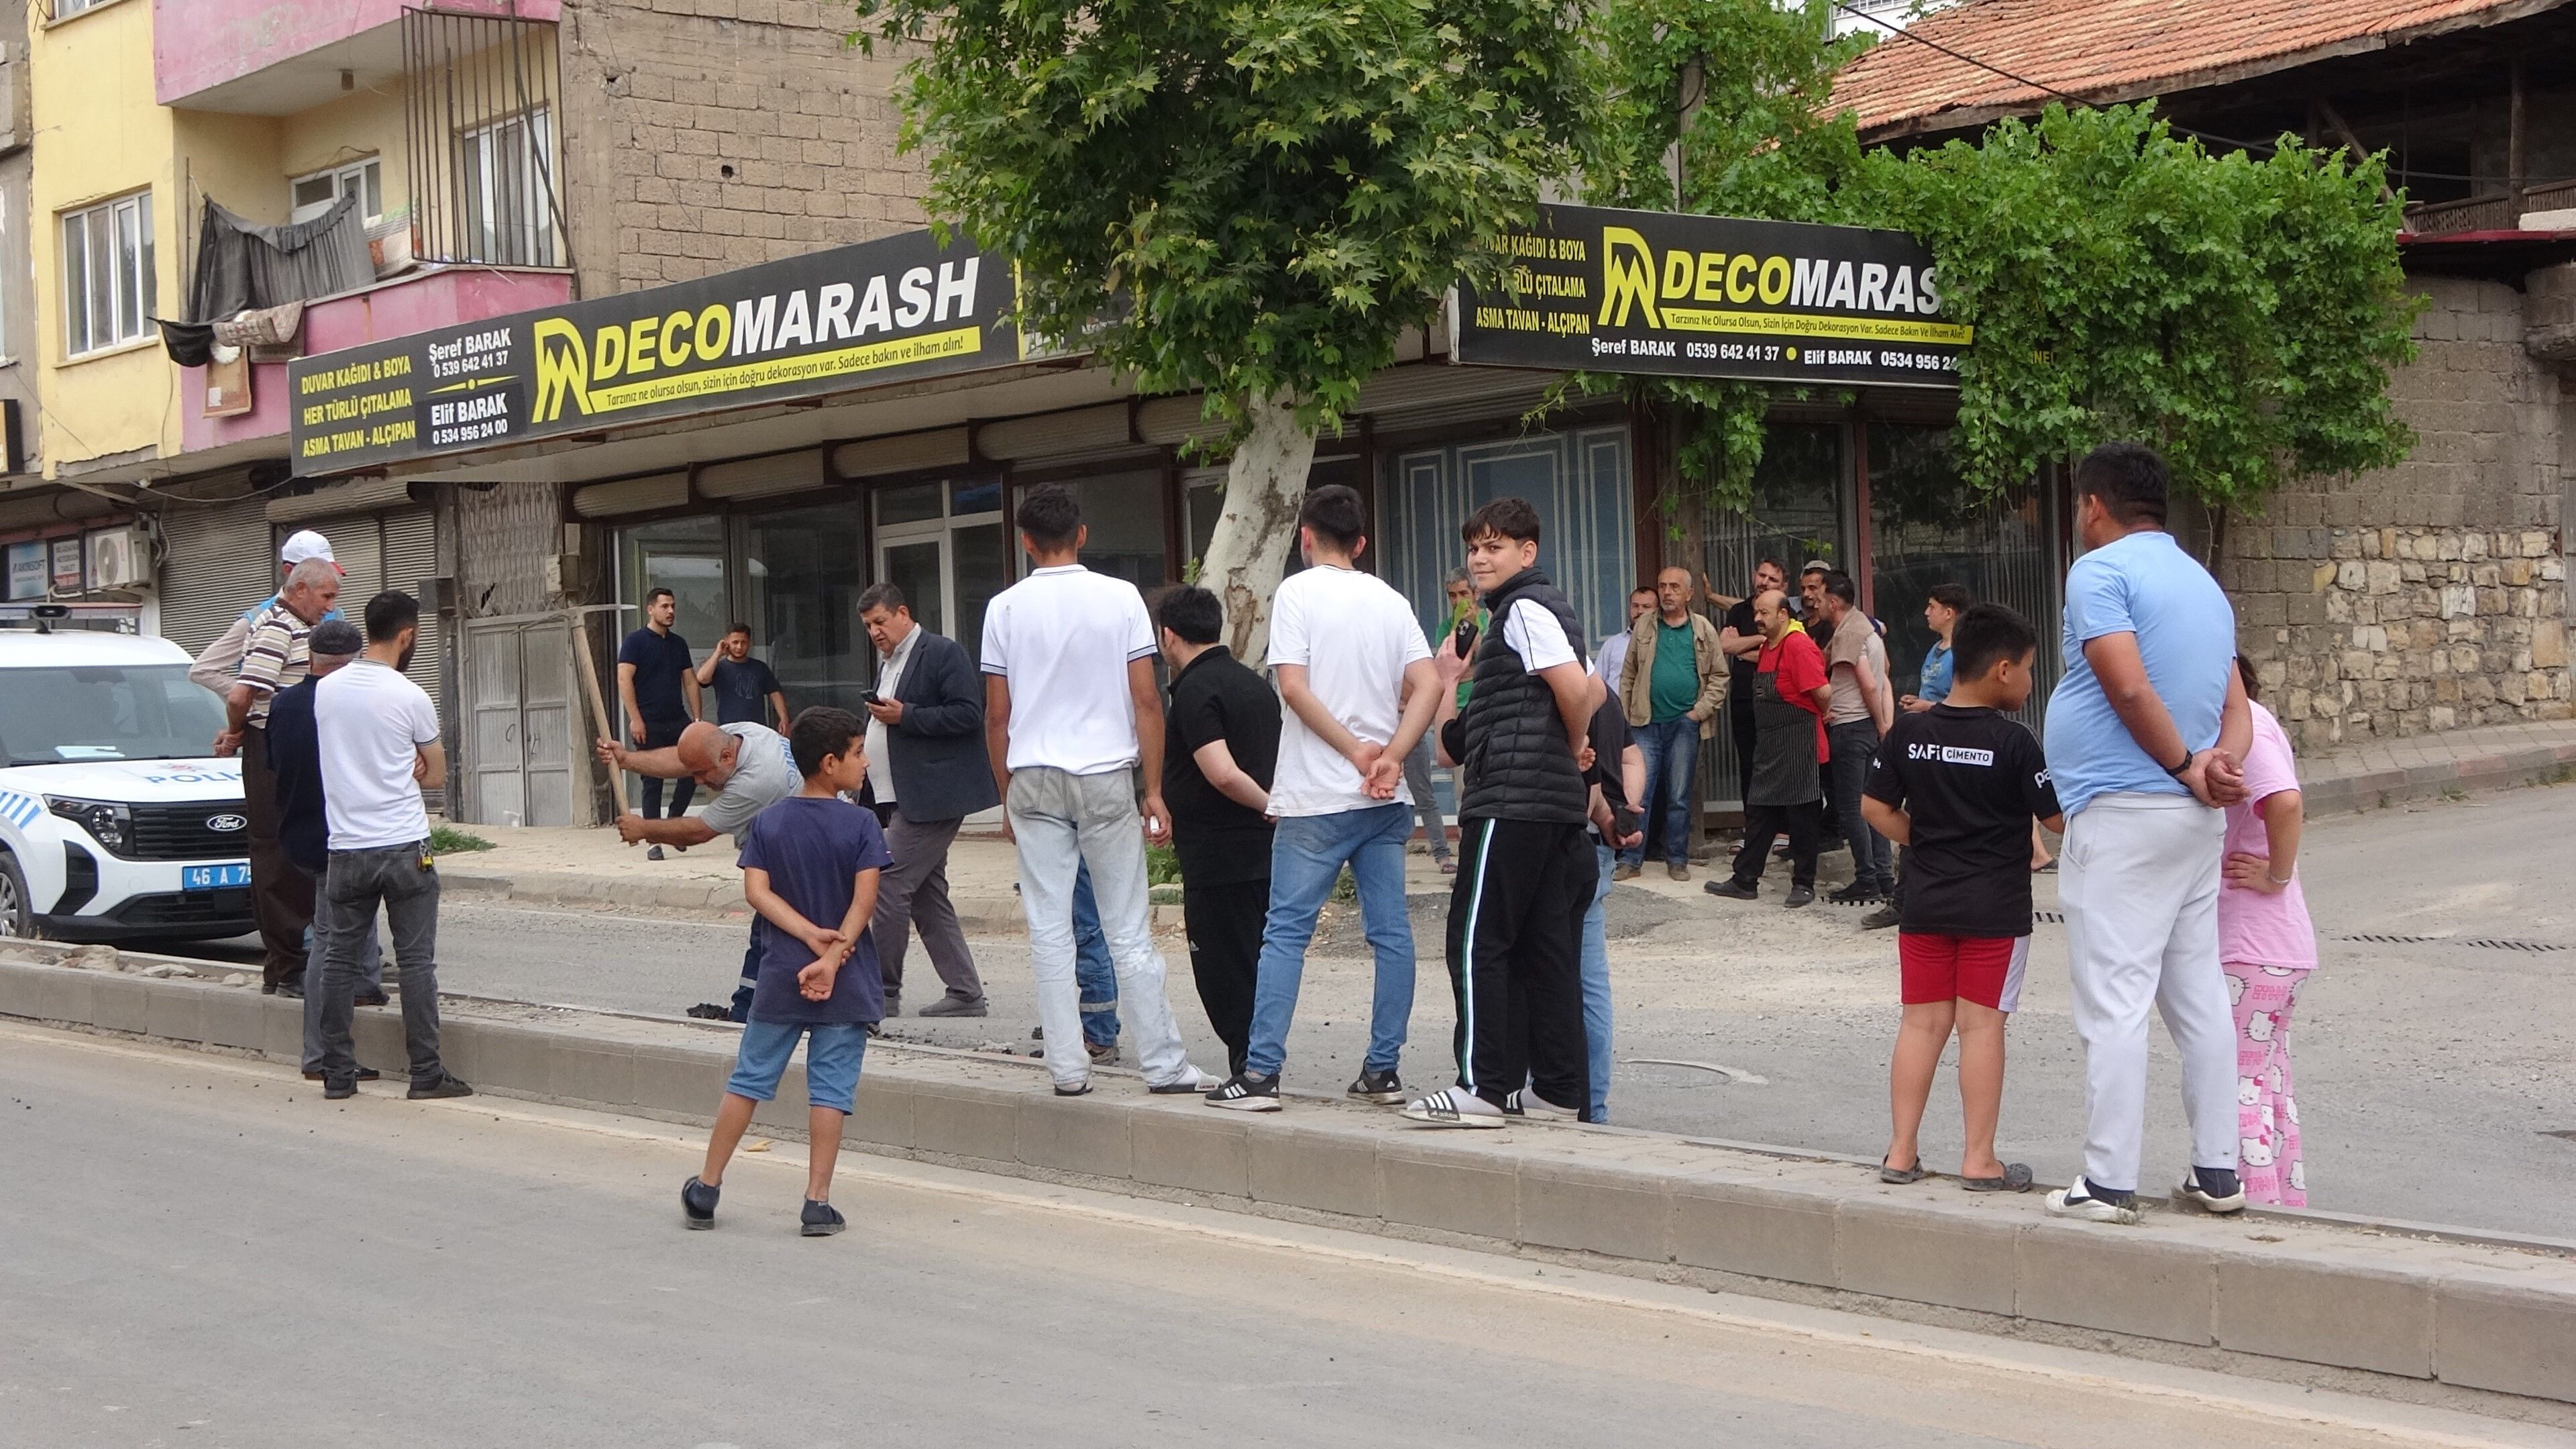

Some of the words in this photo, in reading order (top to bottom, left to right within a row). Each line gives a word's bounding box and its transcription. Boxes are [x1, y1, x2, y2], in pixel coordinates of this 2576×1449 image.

[1511, 232, 1546, 258] KAĞIDI
[1549, 239, 1556, 259] &
[1559, 239, 1586, 261] BOYA
[1536, 274, 1586, 300] ÇITALAMA
[1661, 250, 1940, 315] DECOMARAS
[593, 256, 980, 381] DECOMARASH
[1476, 307, 1505, 329] ASMA
[1506, 309, 1540, 331] TAVAN
[1547, 312, 1590, 338] ALÇIPAN
[1702, 316, 1711, 325] Ne
[1713, 317, 1737, 327] Olursa
[1739, 317, 1761, 329] Olsun,
[1764, 318, 1779, 329] Sizin
[1782, 317, 1794, 332] İçin
[1796, 319, 1817, 333] Doğru
[1819, 321, 1858, 335] Dekorasyon
[1860, 323, 1873, 334] Var.
[1875, 325, 1898, 335] Sadece
[1900, 326, 1919, 336] Bakın
[1920, 327, 1929, 337] Ve
[429, 338, 462, 366] Şeref
[466, 327, 512, 354] BARAK
[1592, 337, 1627, 356] Şeref
[1631, 339, 1676, 357] BARAK
[1686, 341, 1717, 358] 0539
[1720, 343, 1743, 360] 642
[1746, 345, 1760, 360] 41
[1764, 346, 1779, 361] 37
[1804, 350, 1825, 365] Elif
[1828, 350, 1872, 365] BARAK
[1880, 351, 1913, 368] 0534
[1915, 354, 1939, 370] 956
[302, 372, 335, 394] DUVAR
[336, 362, 371, 387] KAĞIDI
[374, 362, 382, 380] &
[384, 356, 411, 378] BOYA
[433, 364, 440, 378] 0
[442, 360, 460, 376] 539
[462, 356, 480, 372] 642
[482, 354, 493, 368] 41
[496, 350, 508, 366] 37
[607, 393, 637, 406] Tarzınız
[639, 390, 648, 400] ne
[651, 385, 674, 398] olursa
[677, 380, 701, 394] olsun,
[703, 376, 721, 390] sizin
[723, 373, 737, 389] için
[739, 369, 765, 388] doğru
[767, 363, 817, 380] dekorasyon
[820, 360, 836, 372] var.
[839, 354, 870, 370] Sadece
[873, 347, 898, 363] bakın
[901, 348, 911, 358] ve
[914, 341, 940, 357] ilham
[943, 335, 963, 352] alın!
[304, 405, 324, 425] HER
[325, 395, 358, 421] TÜRLÜ
[361, 388, 412, 419] ÇITALAMA
[431, 402, 454, 426] Elif
[458, 392, 508, 422] BARAK
[303, 437, 330, 457] ASMA
[331, 430, 364, 451] TAVAN
[372, 420, 415, 447] ALÇIPAN
[433, 431, 439, 445] 0
[441, 427, 459, 443] 534
[461, 425, 479, 441] 956
[480, 421, 494, 438] 24
[495, 419, 508, 434] 00
[214, 817, 239, 828] Ford
[193, 867, 210, 885] 46
[219, 867, 228, 883] A
